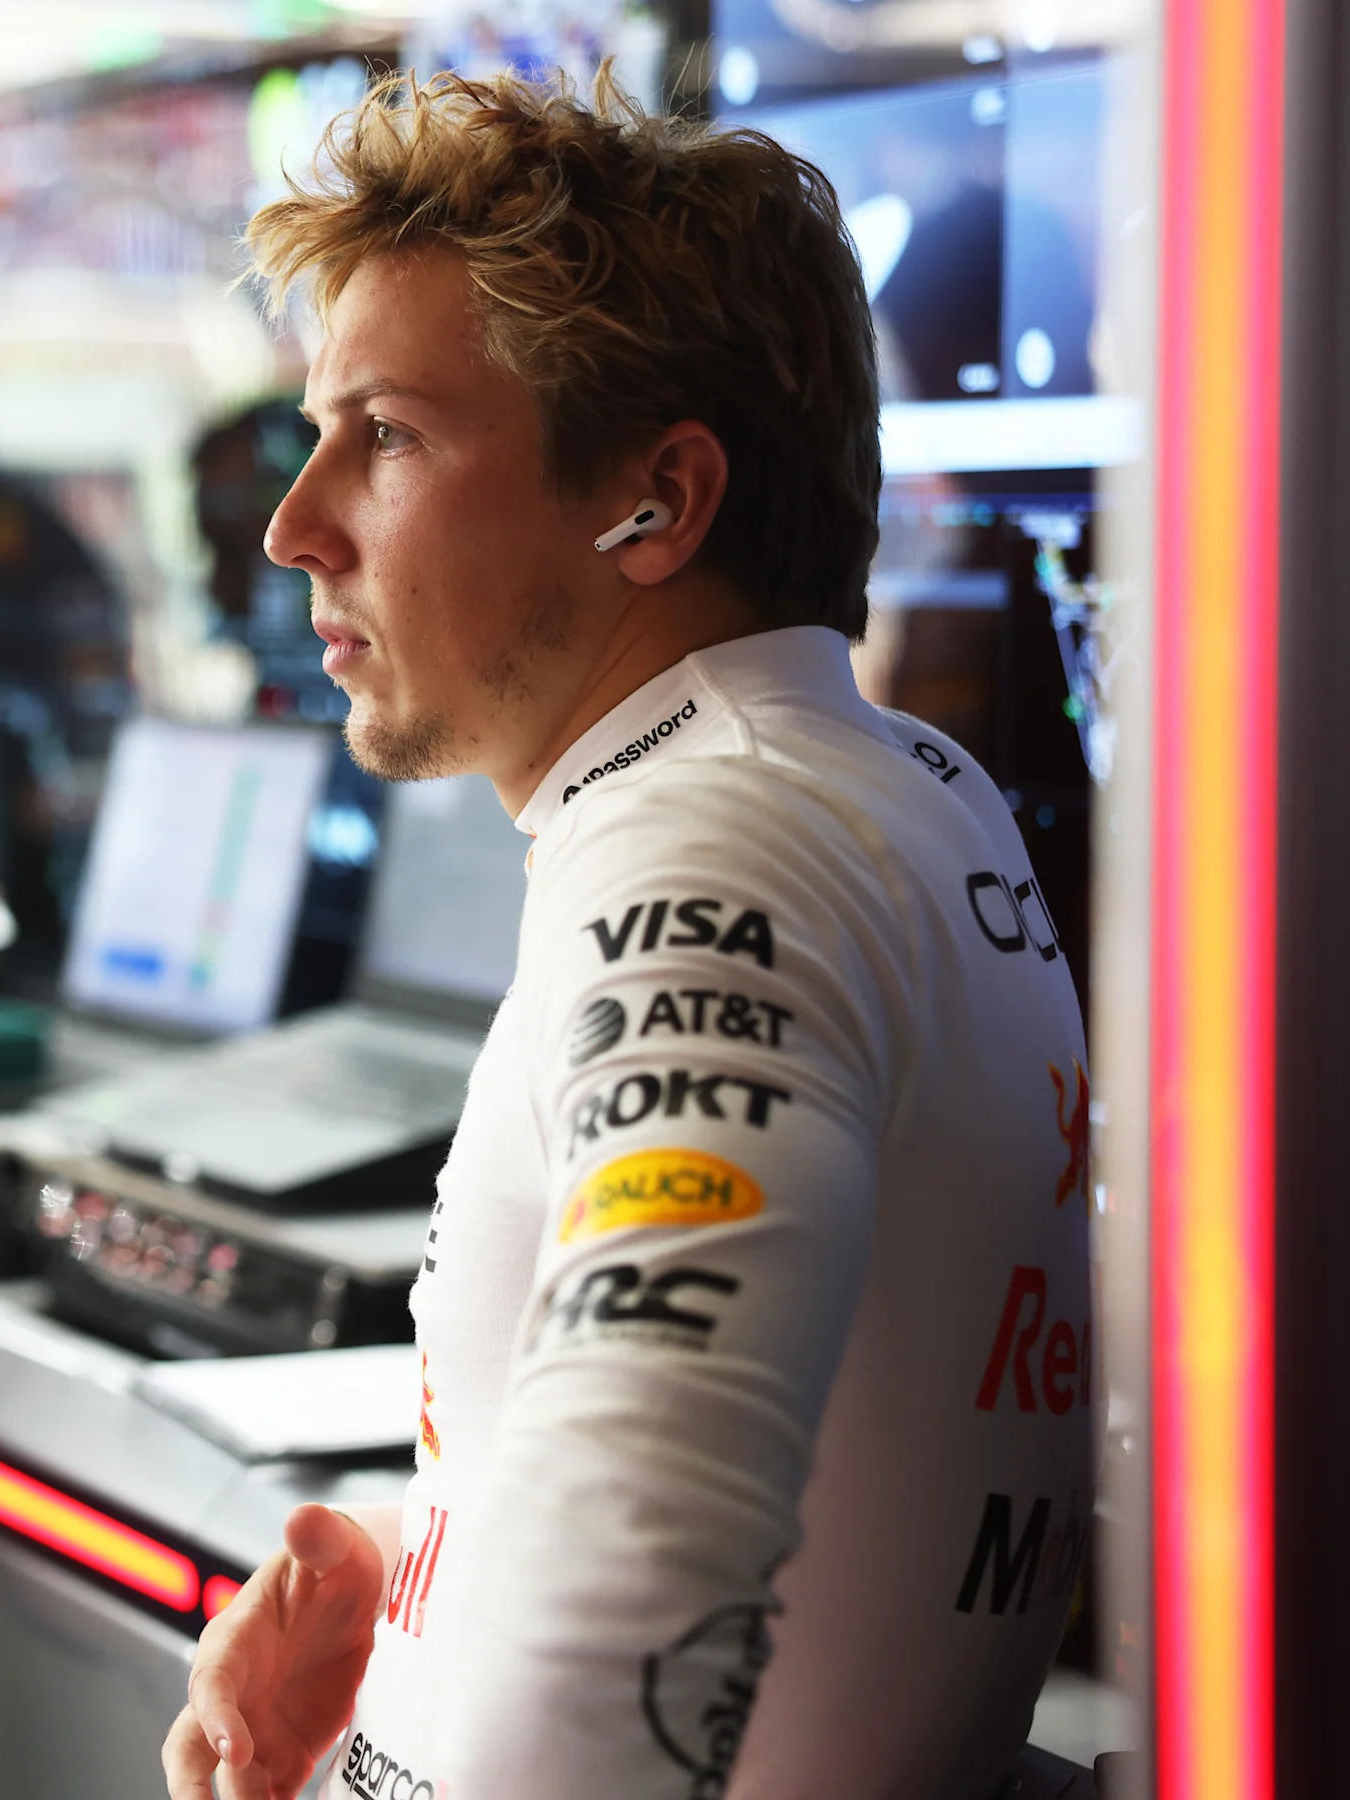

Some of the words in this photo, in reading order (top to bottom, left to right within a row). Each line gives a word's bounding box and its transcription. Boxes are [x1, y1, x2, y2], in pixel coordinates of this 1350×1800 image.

[581, 898, 775, 969] VISA
[640, 989, 794, 1048] AT&T
[568, 1070, 792, 1162] ROKT
[595, 1166, 734, 1209] RAUCH
[386, 1505, 449, 1639] ull
[348, 1732, 435, 1800] sparco
